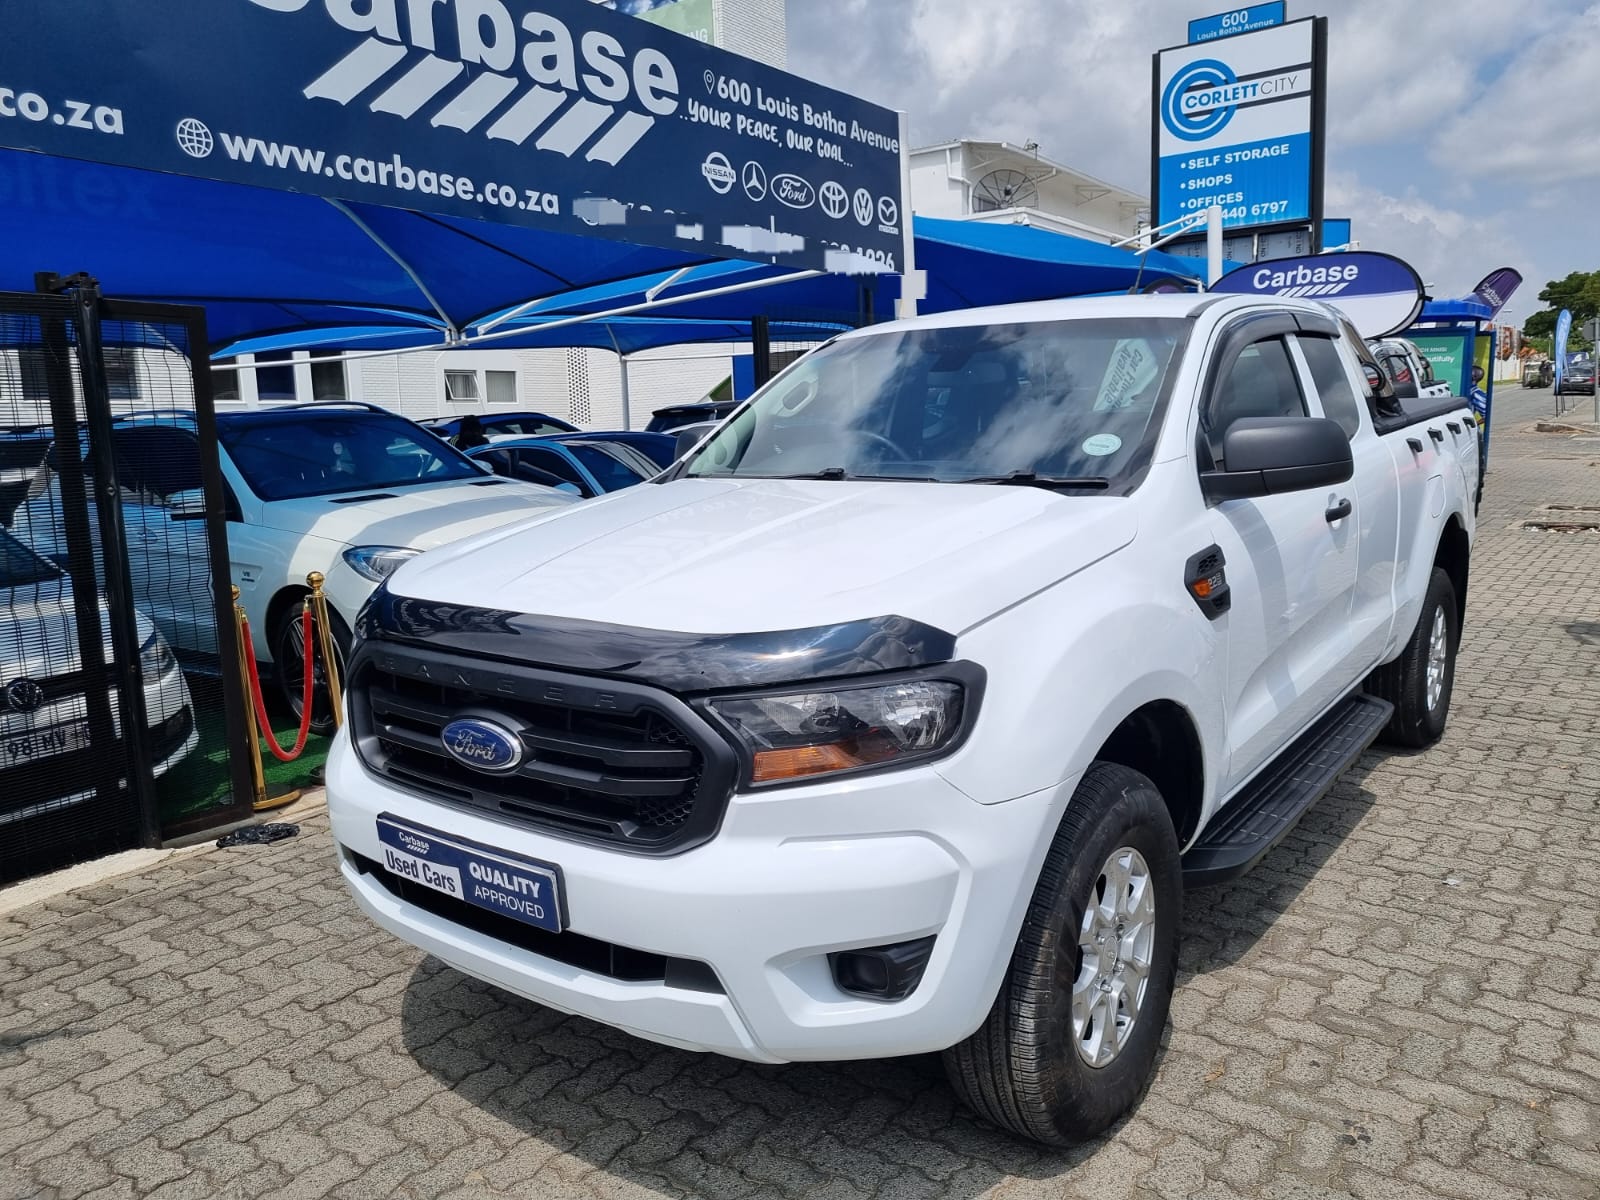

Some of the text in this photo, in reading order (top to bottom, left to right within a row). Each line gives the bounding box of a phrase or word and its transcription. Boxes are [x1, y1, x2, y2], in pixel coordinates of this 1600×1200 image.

[1197, 18, 1274, 41] Louis Botha Avenue
[1222, 11, 1249, 28] 600
[248, 0, 680, 115] arbase
[717, 75, 899, 153] 600 Louis Botha Avenue
[736, 113, 783, 148] PEACE,
[786, 128, 813, 153] OUR
[1188, 143, 1290, 170] SELF STORAGE
[219, 132, 560, 215] www.carbase.co.za
[704, 166, 735, 181] NISSAN
[1188, 174, 1233, 190] SHOPS
[779, 178, 807, 203] Ford
[1187, 192, 1244, 209] OFFICES
[1222, 206, 1247, 219] 440
[1251, 200, 1289, 216] 6797
[1253, 264, 1359, 290] Carbase
[452, 730, 496, 762] Ford
[398, 831, 430, 850] Carbase
[385, 849, 456, 893] Used Cars
[469, 862, 541, 899] QUALITY
[474, 885, 545, 920] APPROVED
